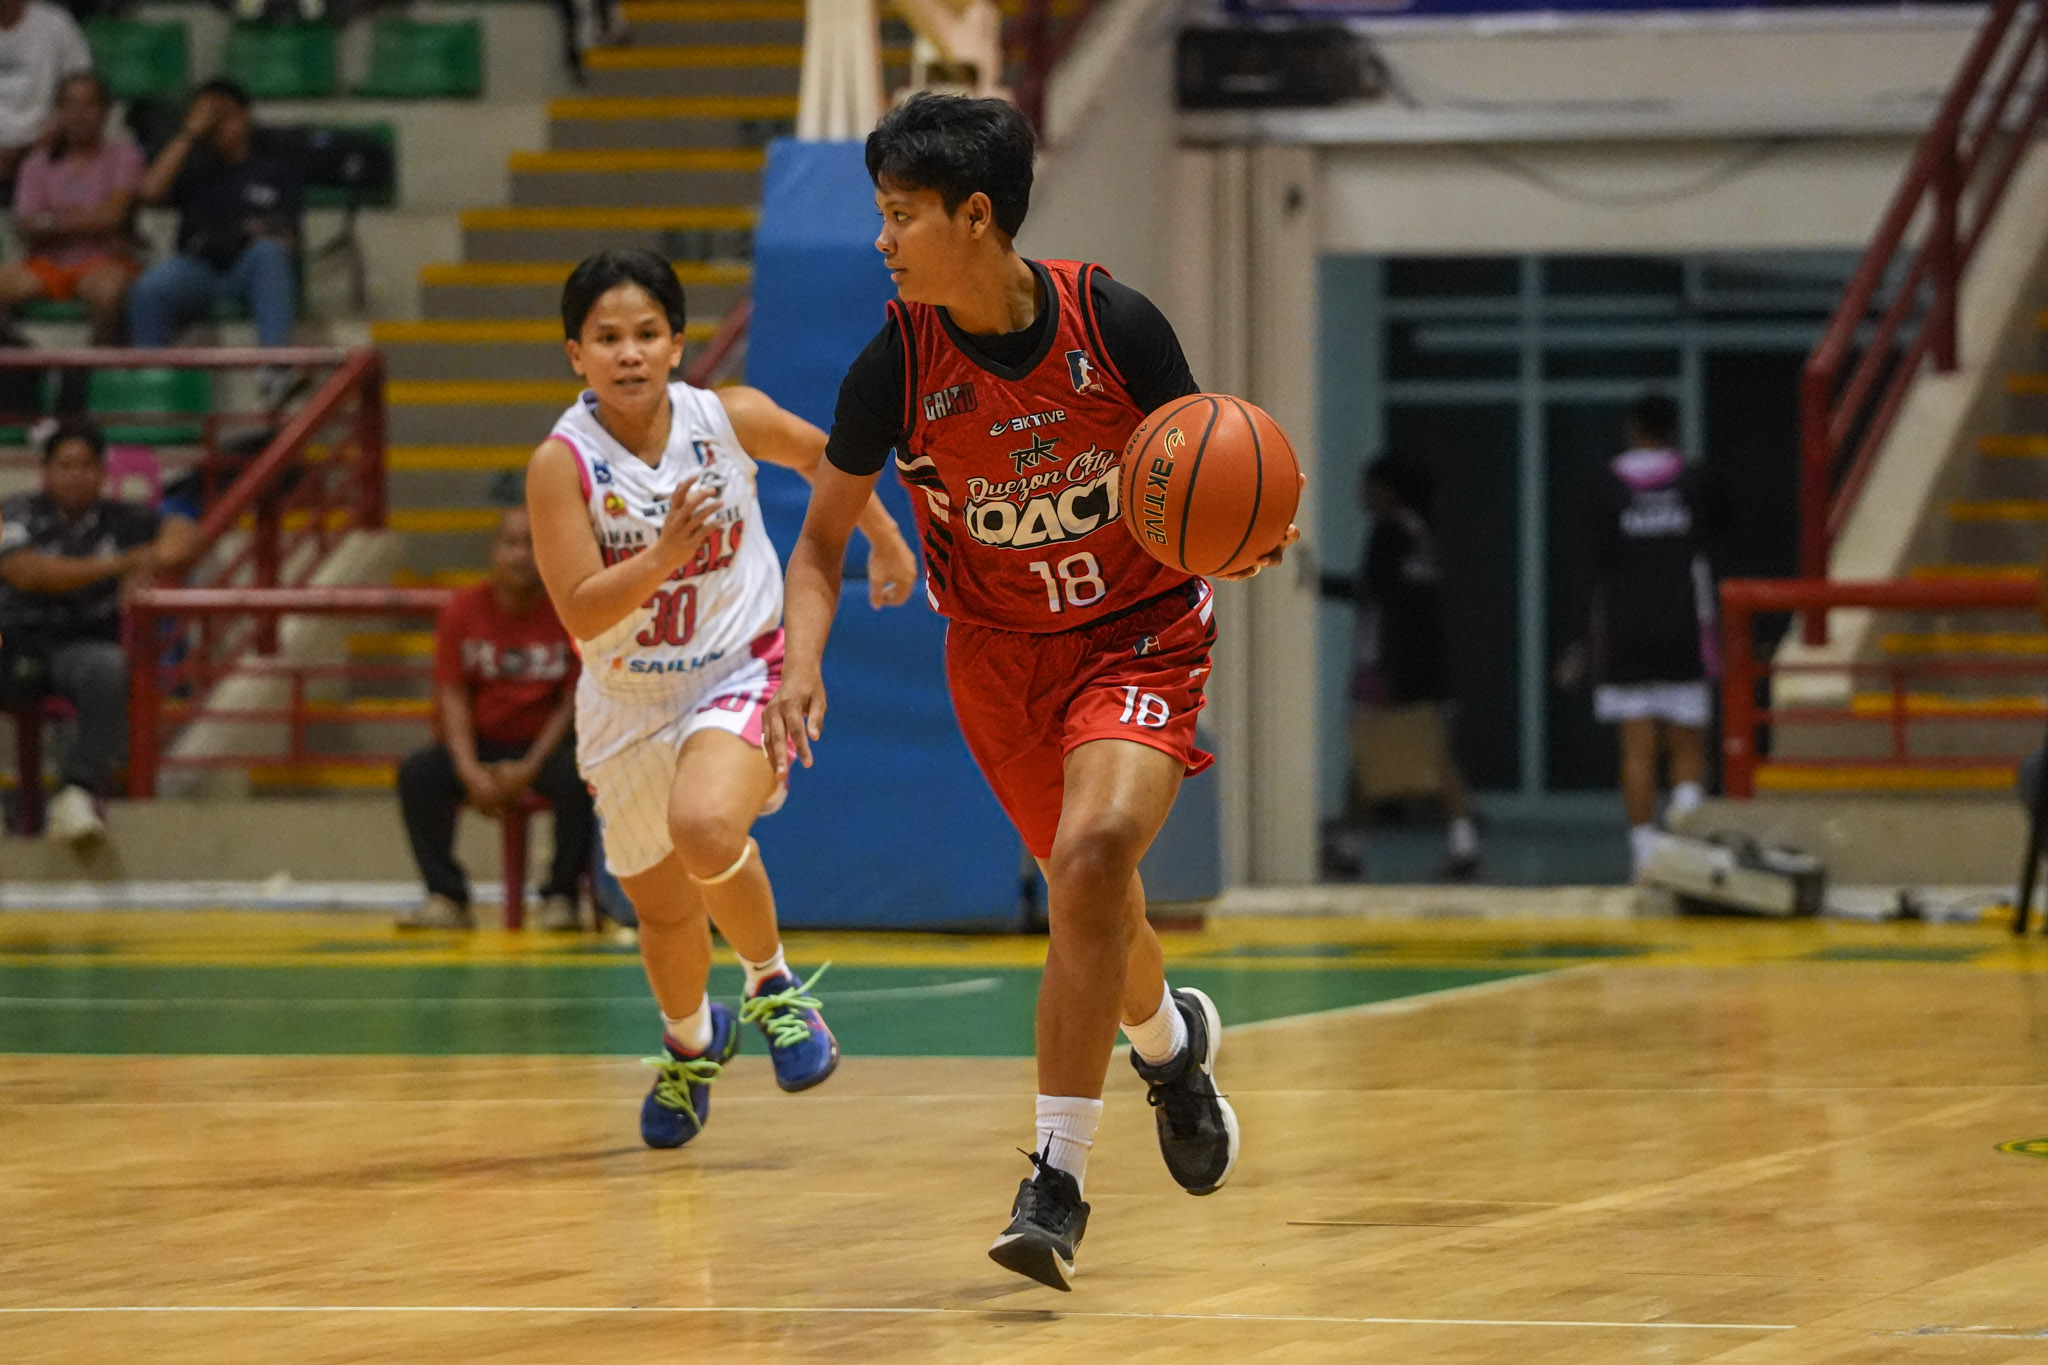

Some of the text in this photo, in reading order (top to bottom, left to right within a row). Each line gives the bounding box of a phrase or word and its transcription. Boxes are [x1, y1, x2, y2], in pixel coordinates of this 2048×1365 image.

[966, 443, 1117, 502] Quezon City
[1029, 551, 1108, 613] 18
[636, 584, 698, 646] 30
[1119, 685, 1171, 730] 18
